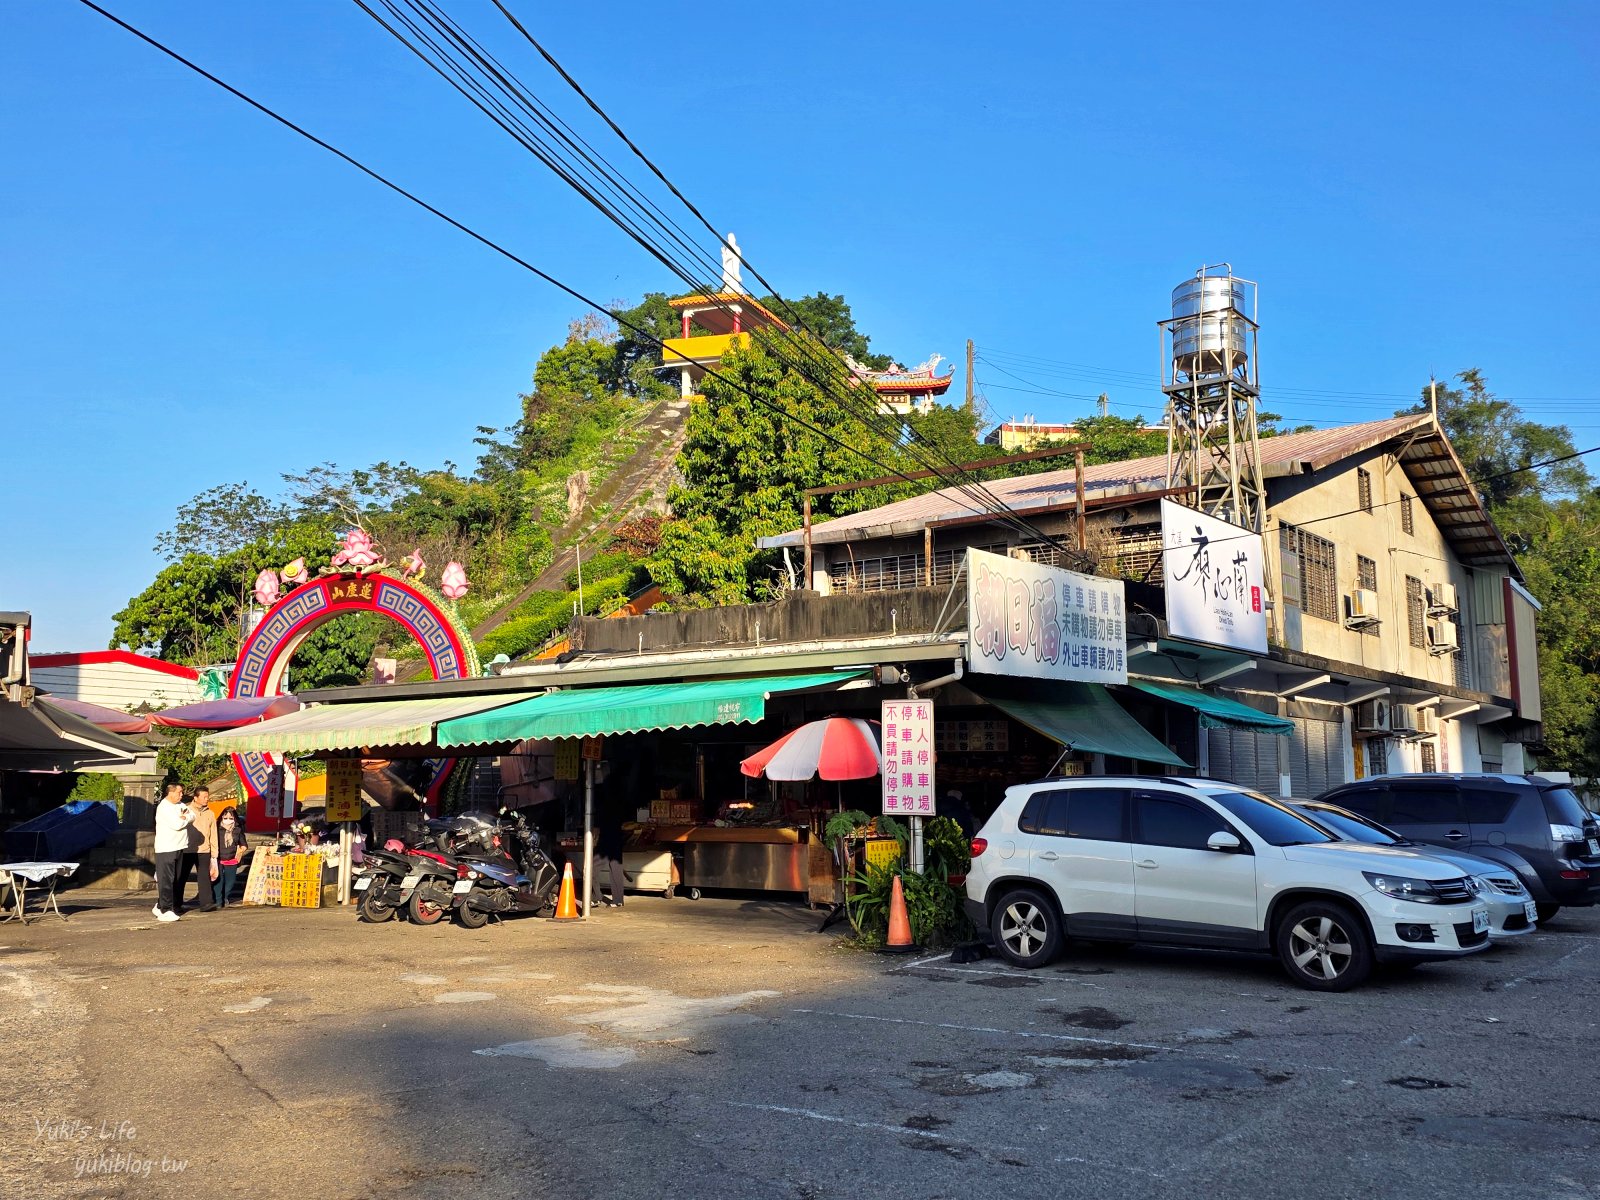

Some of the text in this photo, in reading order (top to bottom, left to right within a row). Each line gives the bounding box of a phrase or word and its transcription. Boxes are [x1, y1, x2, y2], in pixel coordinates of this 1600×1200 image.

[974, 563, 1061, 666] 朝日福
[1062, 582, 1121, 617] 停車請購物
[1062, 611, 1122, 643] 未購物請勿停車
[1062, 641, 1123, 672] 外出車輛請勿停
[886, 706, 898, 810] 不買請勿停車
[901, 706, 914, 811] 停車請購物
[916, 705, 930, 811] 私人停車場
